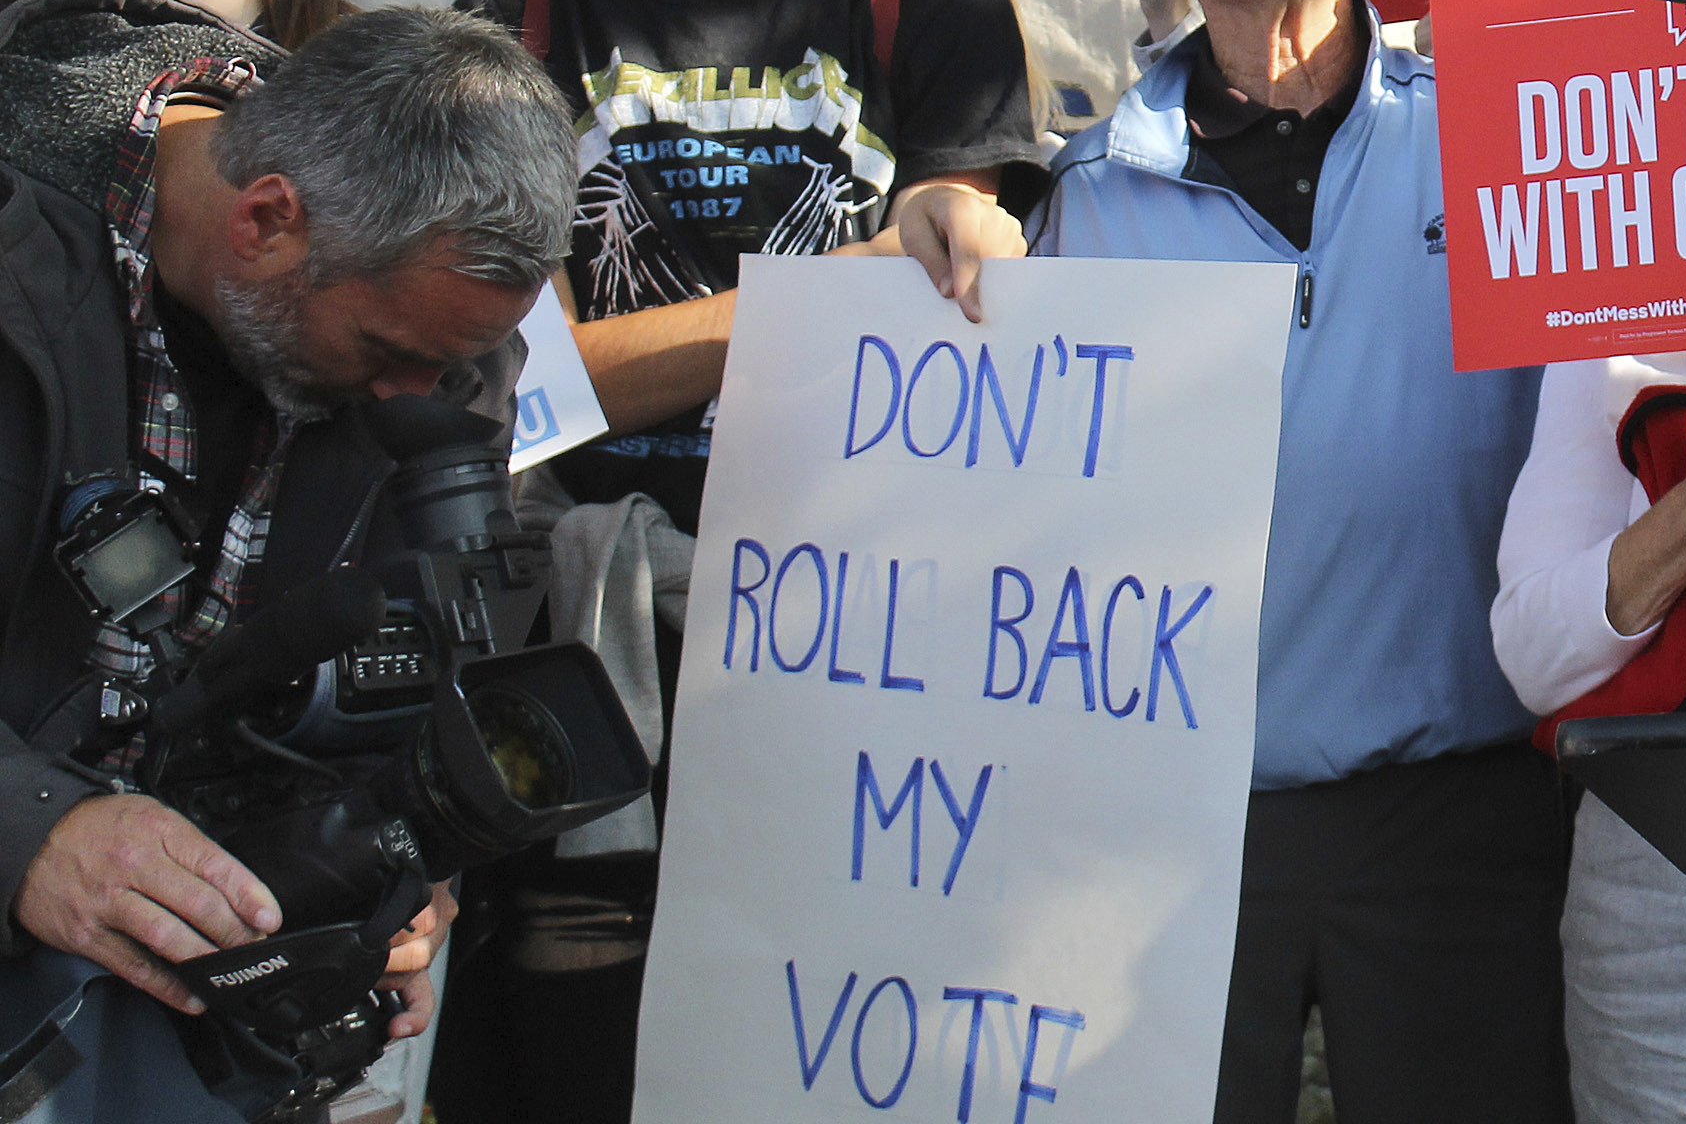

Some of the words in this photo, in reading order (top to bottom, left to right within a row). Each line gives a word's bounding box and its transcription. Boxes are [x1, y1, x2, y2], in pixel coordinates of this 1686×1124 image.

[614, 137, 801, 165] EUROPEAN
[659, 164, 749, 189] TOUR
[1476, 168, 1657, 280] WITH
[844, 334, 1135, 477] DON'T
[723, 538, 925, 692] ROLL
[983, 566, 1213, 729] BACK
[850, 749, 993, 896] MY
[209, 954, 290, 989] FUJINON
